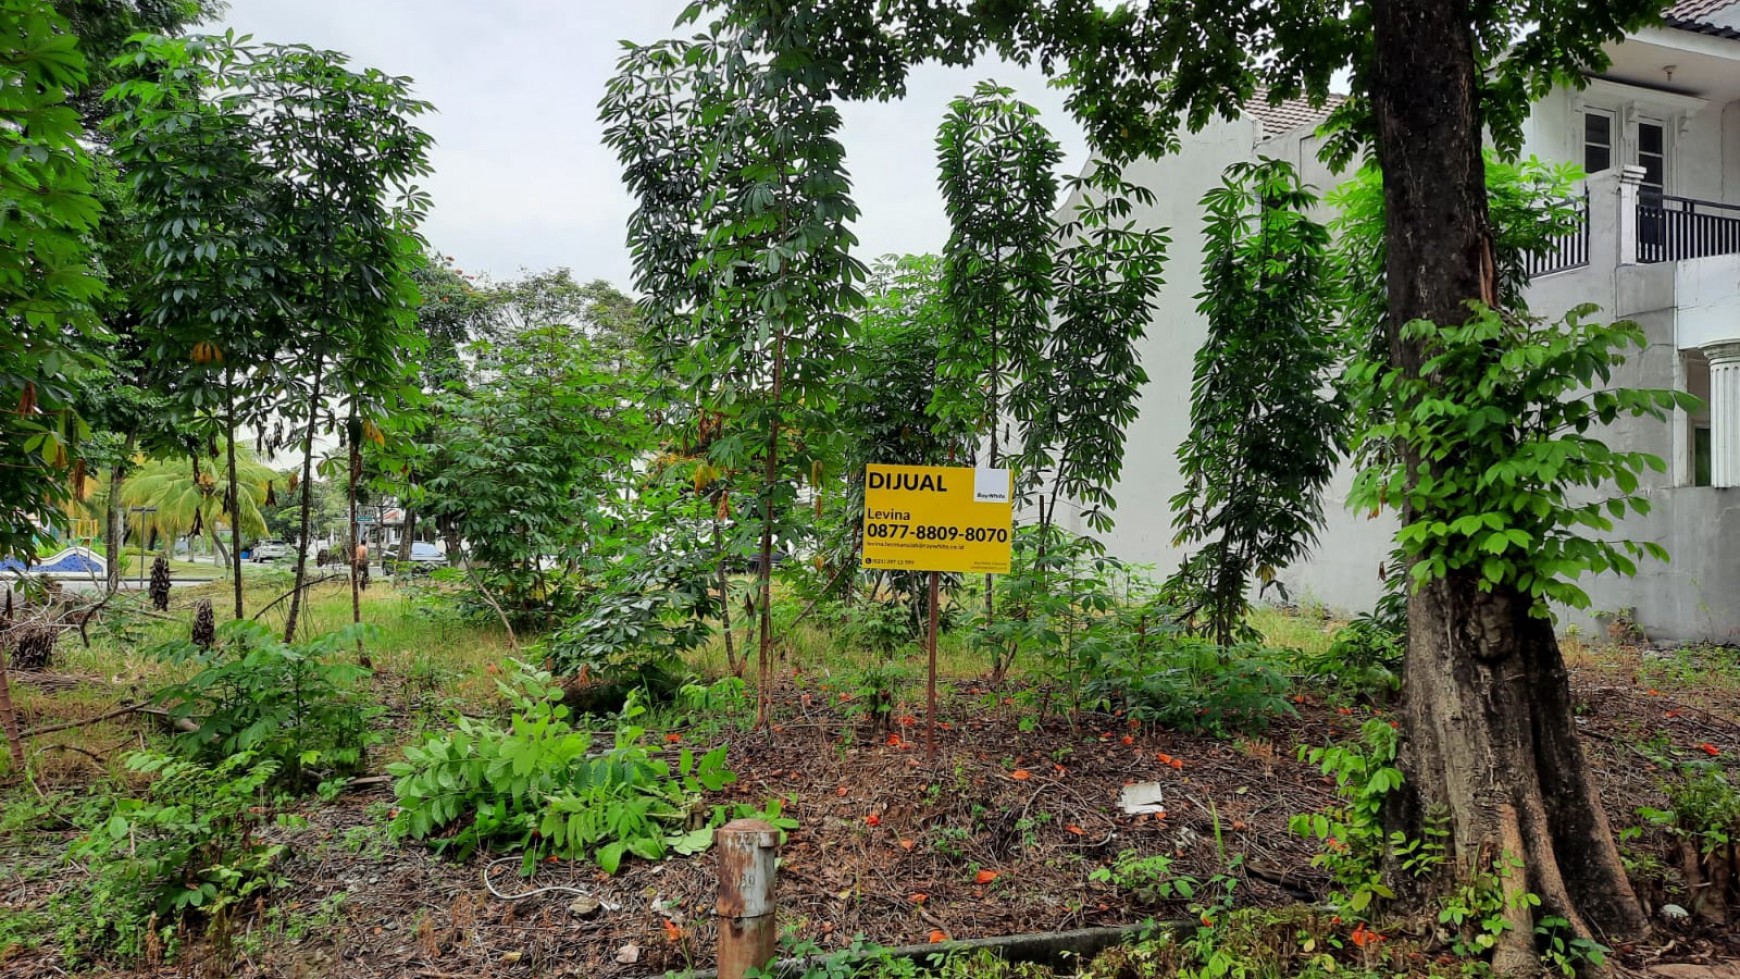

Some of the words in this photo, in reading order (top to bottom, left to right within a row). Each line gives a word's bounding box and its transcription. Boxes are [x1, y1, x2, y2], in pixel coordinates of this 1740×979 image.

[868, 472, 948, 492] DIJUAL
[867, 508, 911, 521] Levina
[867, 523, 1008, 543] 0877-8809-8070
